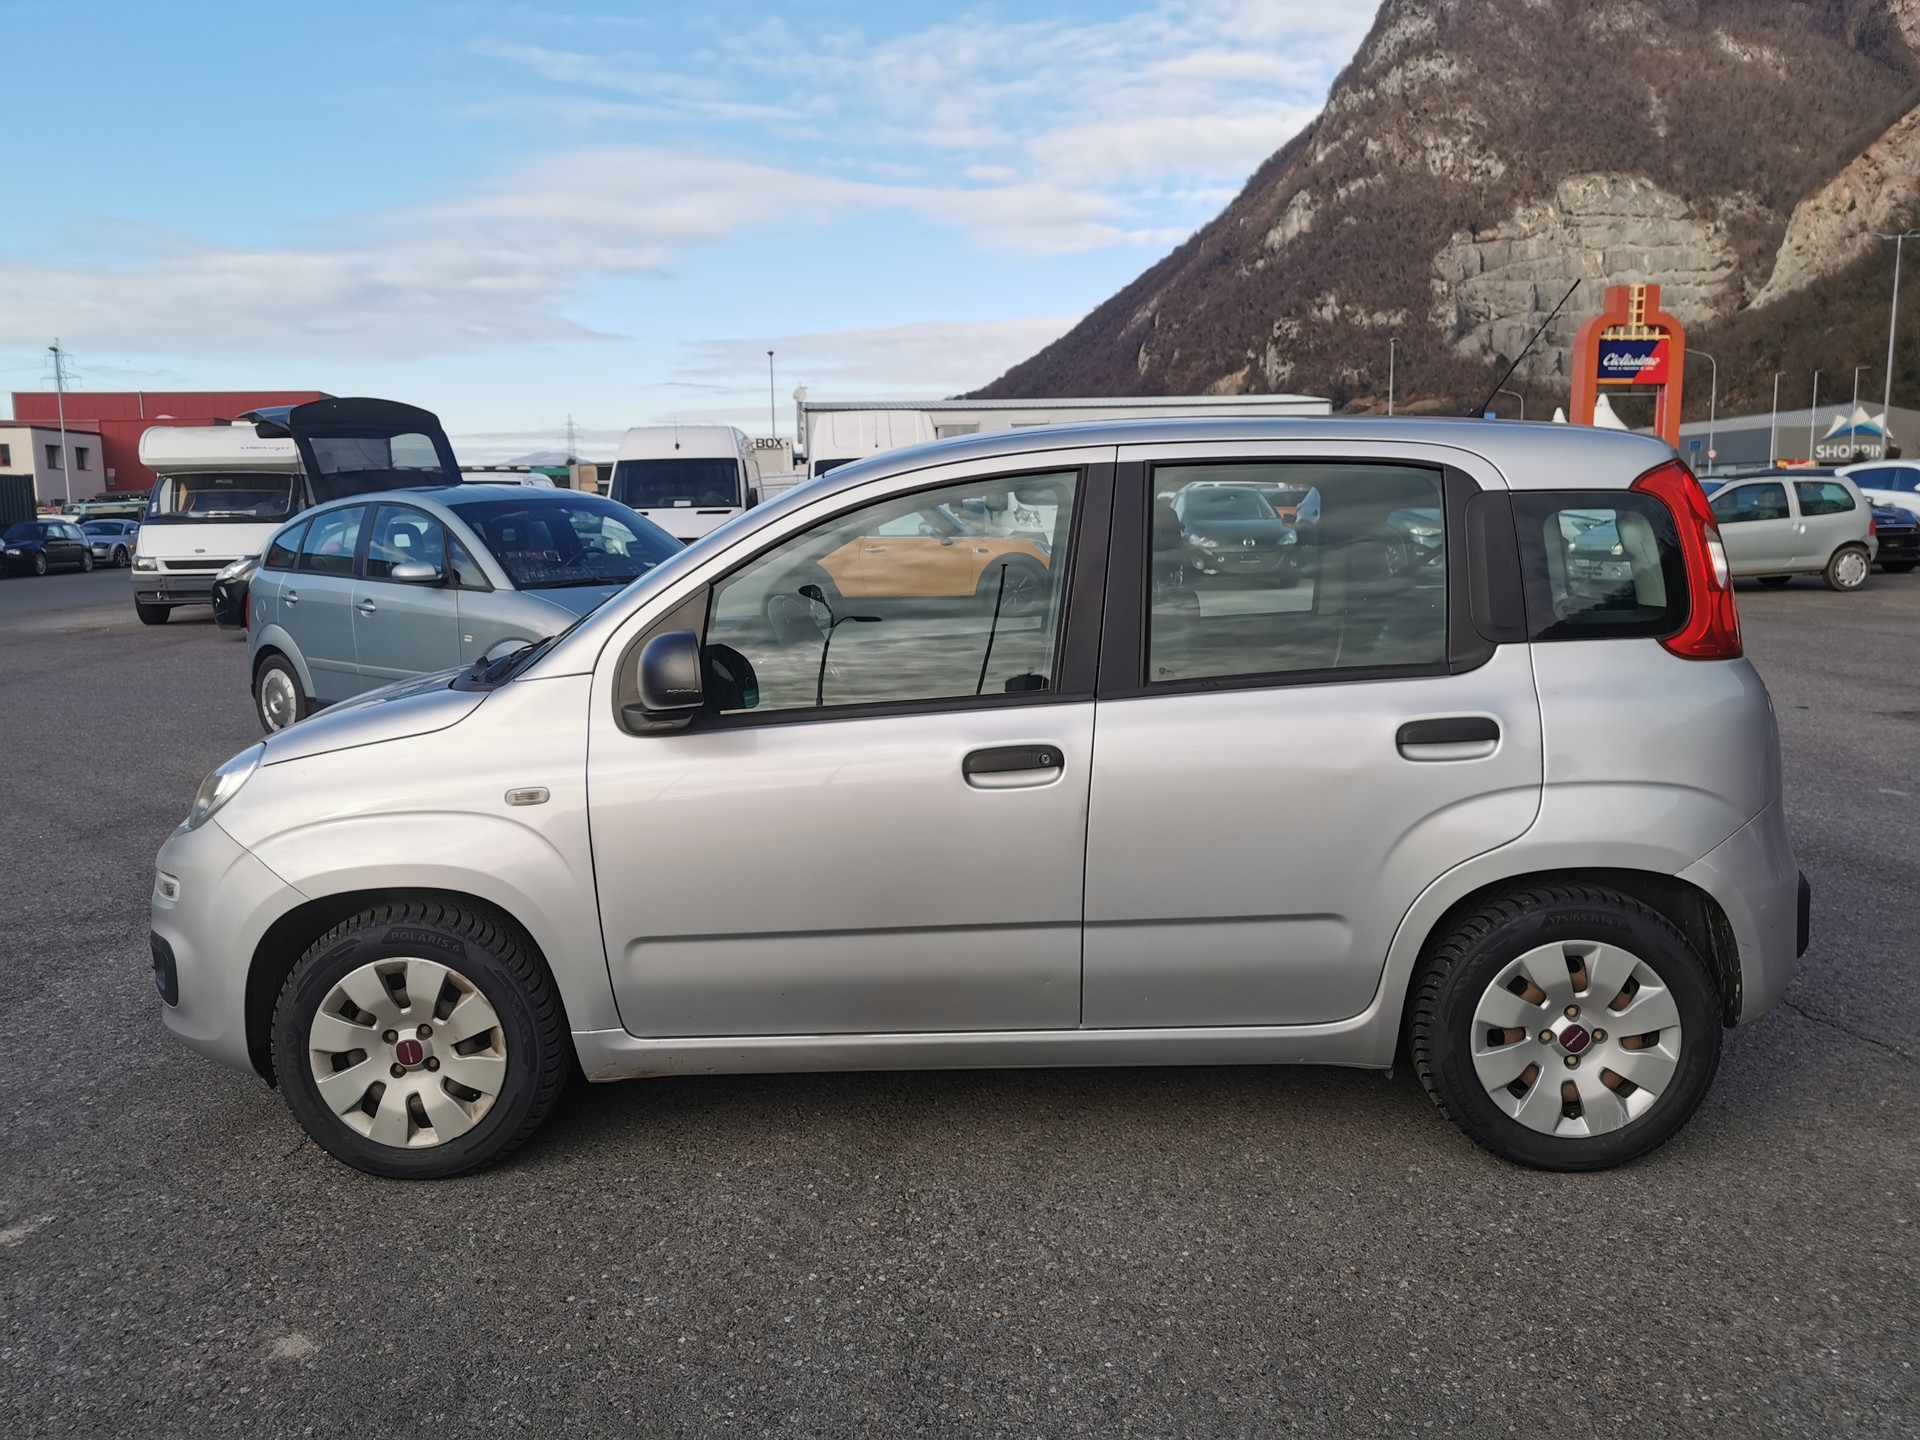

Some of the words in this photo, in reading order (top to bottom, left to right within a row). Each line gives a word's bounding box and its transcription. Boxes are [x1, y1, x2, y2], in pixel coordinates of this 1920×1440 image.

[1549, 912, 1588, 925] 175/65
[391, 931, 450, 948] POLARIS
[452, 944, 461, 953] 6
